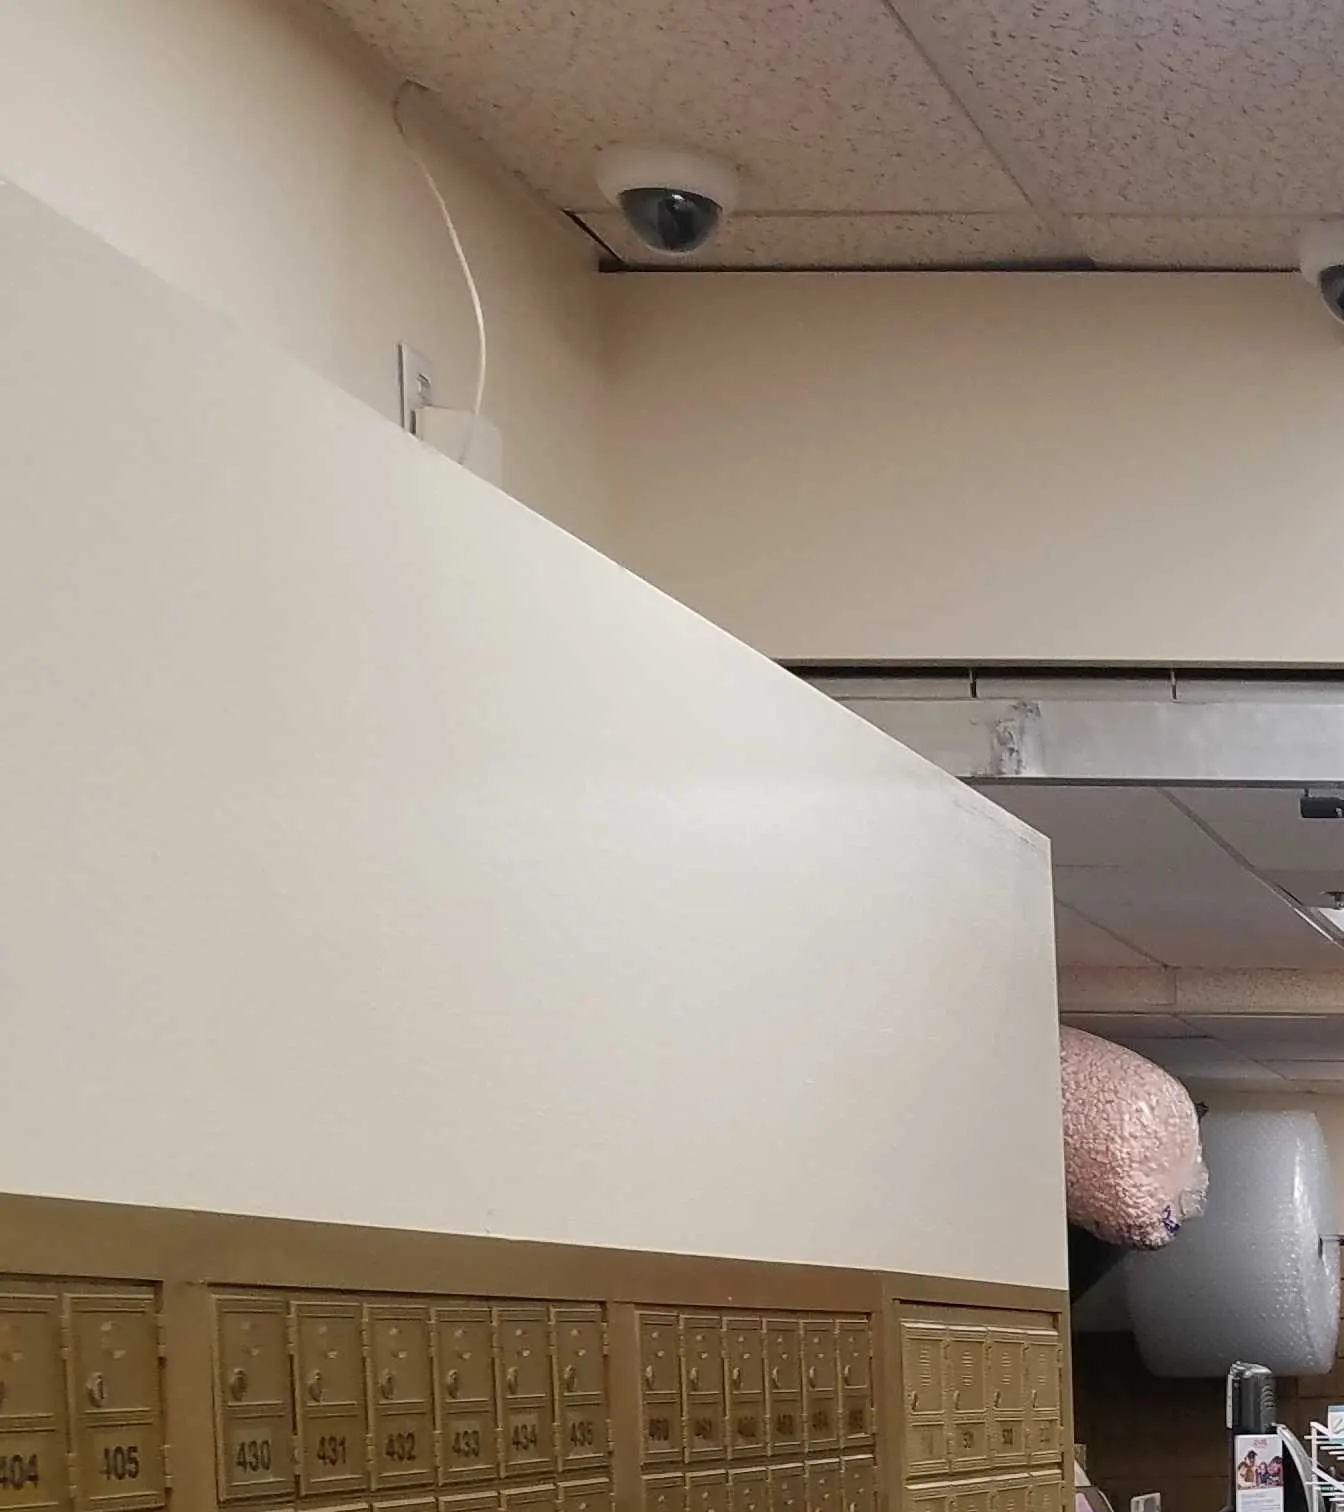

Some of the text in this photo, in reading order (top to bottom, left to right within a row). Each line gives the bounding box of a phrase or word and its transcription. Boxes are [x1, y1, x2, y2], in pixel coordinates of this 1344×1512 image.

[384, 1430, 416, 1463] 432
[452, 1429, 480, 1458] 433
[511, 1424, 539, 1451] 434
[569, 1420, 595, 1449] 435
[236, 1439, 272, 1473] 430
[316, 1434, 347, 1468] 431
